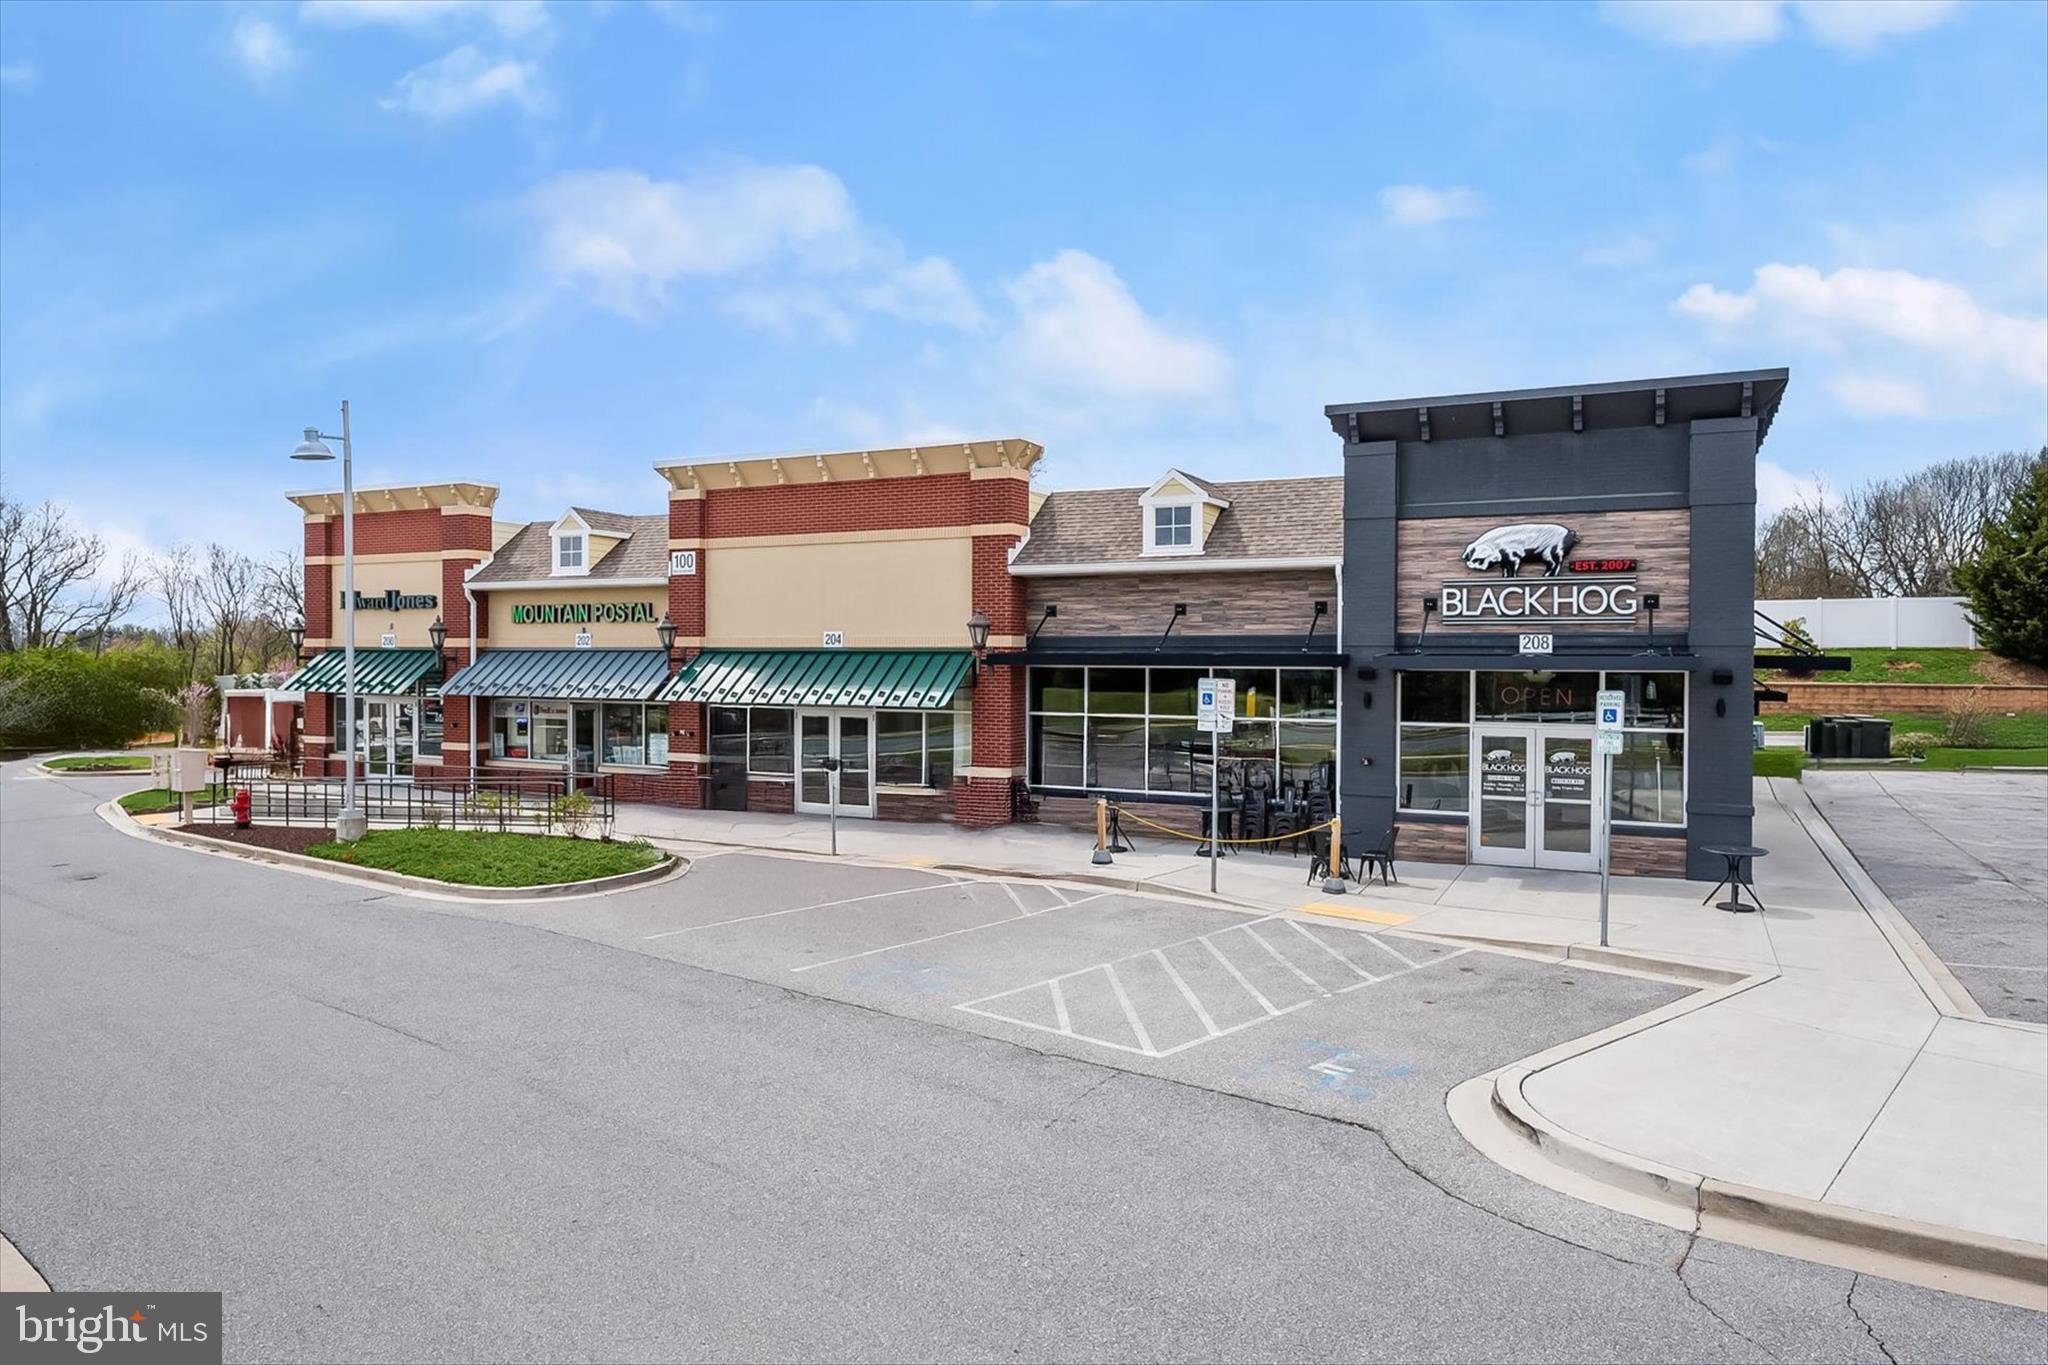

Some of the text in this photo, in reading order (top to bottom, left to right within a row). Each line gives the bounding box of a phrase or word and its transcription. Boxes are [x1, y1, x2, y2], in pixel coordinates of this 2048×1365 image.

[674, 553, 694, 569] 100
[1602, 559, 1631, 571] 2007
[385, 590, 437, 611] Jones
[512, 603, 659, 623] MOUNTAIN POSTAL
[576, 635, 590, 646] 202
[825, 633, 842, 645] 204
[1522, 635, 1550, 650] 208
[1501, 686, 1573, 706] OPEN
